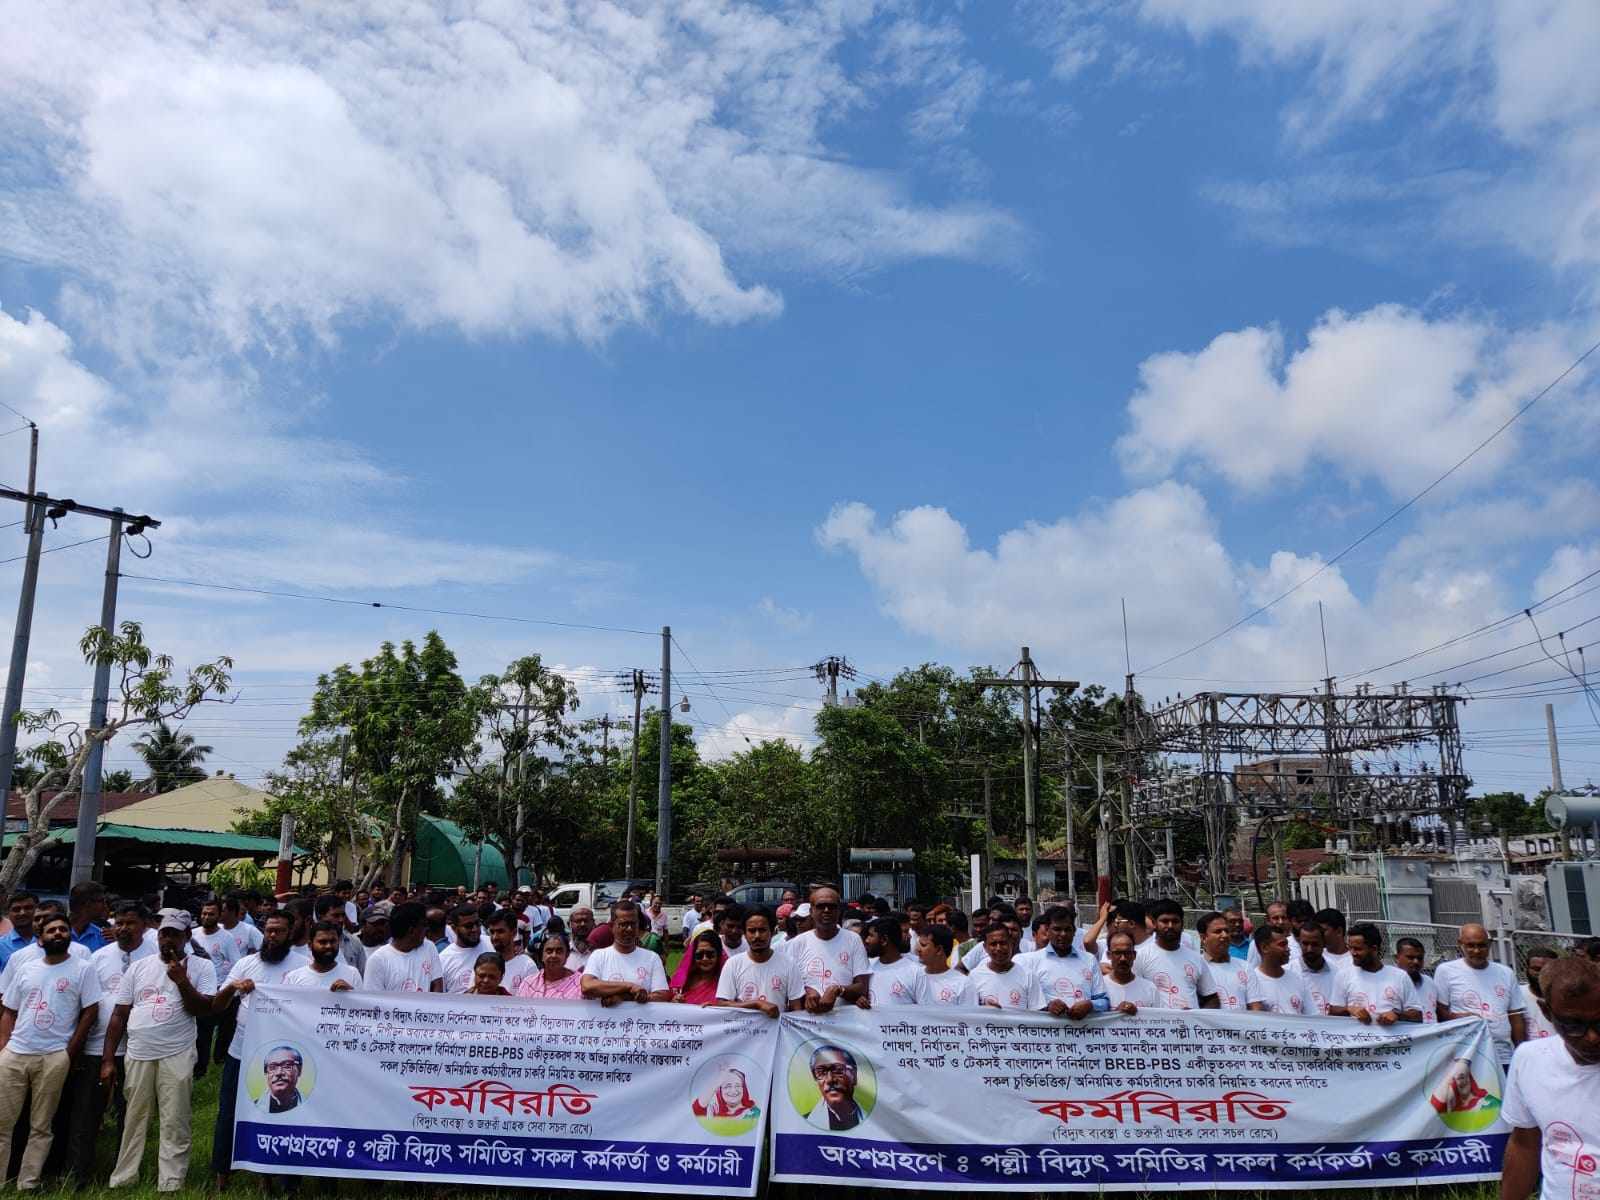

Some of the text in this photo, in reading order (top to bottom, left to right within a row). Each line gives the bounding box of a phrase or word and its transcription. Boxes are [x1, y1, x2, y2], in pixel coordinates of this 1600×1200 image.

[880, 1021, 917, 1036] মাননীয়
[921, 1022, 969, 1037] প্রধানমন্ত্রী
[975, 1026, 982, 1035] ও
[985, 1023, 1014, 1038] বিদ্যুৎ
[1018, 1024, 1060, 1038] বিভাগের
[1063, 1024, 1105, 1038] নির্দেশনা
[1110, 1028, 1140, 1038] অমান্য
[1144, 1028, 1165, 1038] করে
[1170, 1025, 1190, 1039] পল্লী
[1193, 1025, 1240, 1040] বিদ্যুতায়ন
[1245, 1028, 1267, 1041] বোর্ড
[1271, 1028, 1297, 1044] কর্তৃক
[469, 1045, 524, 1060] BREB-PBS
[898, 1057, 920, 1070] এবং
[922, 1054, 946, 1068] স্মার্ট
[951, 1058, 959, 1068] ও
[964, 1056, 1001, 1070] টেকসই
[1003, 1058, 1053, 1071] বাংলাদেশ
[1105, 1058, 1181, 1070] BREB-PBS
[1250, 1060, 1265, 1072] সহ
[1268, 1058, 1294, 1073] অভিন্ন
[1297, 1059, 1343, 1072] চাকরিবিধি
[1348, 1061, 1389, 1073] বাস্তবায়ন
[1393, 1061, 1402, 1070] ও
[982, 1076, 1010, 1088] সকল
[1013, 1073, 1071, 1090] চুক্তিভিত্তিক/
[1075, 1074, 1122, 1088] অনিয়মিত
[1127, 1073, 1182, 1088] কর্মচারীদের
[1185, 1074, 1215, 1088] চাকরি
[1219, 1074, 1256, 1089] নিয়মিত
[1295, 1076, 1328, 1089] দাবিতে
[408, 1079, 599, 1117] কর্মবিরতি
[1030, 1090, 1293, 1124] কর্মবিরতি
[256, 1133, 342, 1159] অংশগ্রহণে
[363, 1133, 400, 1162] পল্লী
[403, 1135, 453, 1167] বিদ্যুৎ
[458, 1138, 527, 1168] সমিতির
[531, 1148, 578, 1169] সকল
[582, 1144, 650, 1173] কর্মকর্তা
[656, 1154, 670, 1172] ও
[676, 1147, 743, 1176] কর্মচারী
[818, 1145, 946, 1174] অংশগ্রহণে
[980, 1148, 1030, 1175] পল্লী
[1037, 1148, 1109, 1178] বিদ্যুৎ
[1114, 1147, 1207, 1173] সমিতির
[1213, 1152, 1278, 1173] সকল
[1284, 1146, 1373, 1172] কর্মকর্তা
[1382, 1152, 1401, 1168] ও
[1407, 1138, 1492, 1167] কর্মচারী
